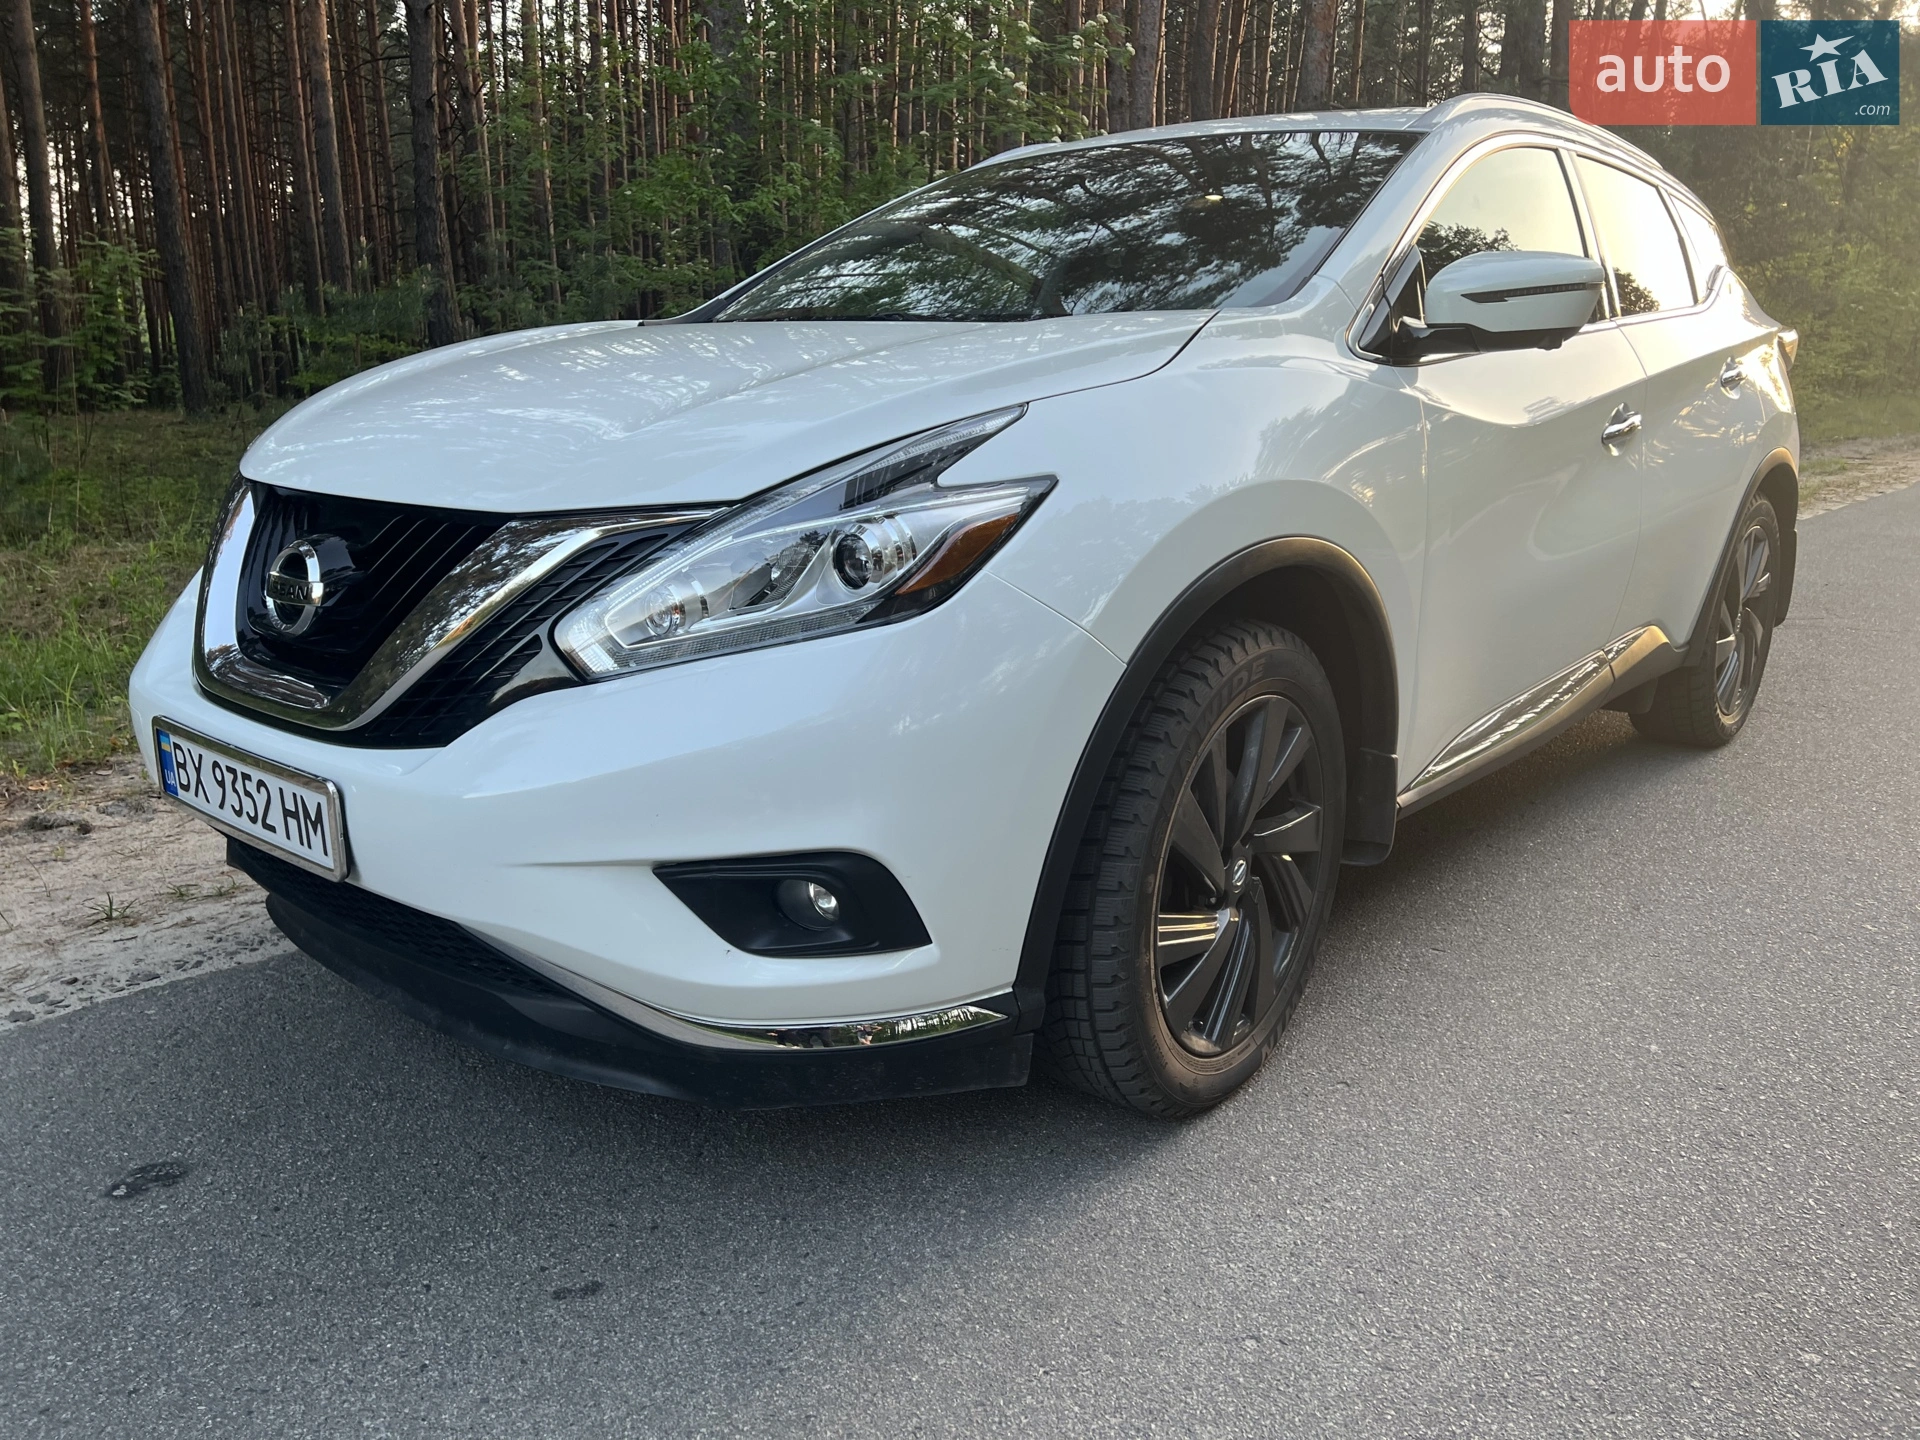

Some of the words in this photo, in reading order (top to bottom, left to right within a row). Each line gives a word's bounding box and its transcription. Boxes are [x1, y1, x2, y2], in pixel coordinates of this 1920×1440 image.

[269, 579, 309, 601] SSAN
[165, 769, 176, 787] UA
[172, 741, 210, 804] BX
[212, 760, 277, 834] 9352
[279, 787, 328, 857] HM
